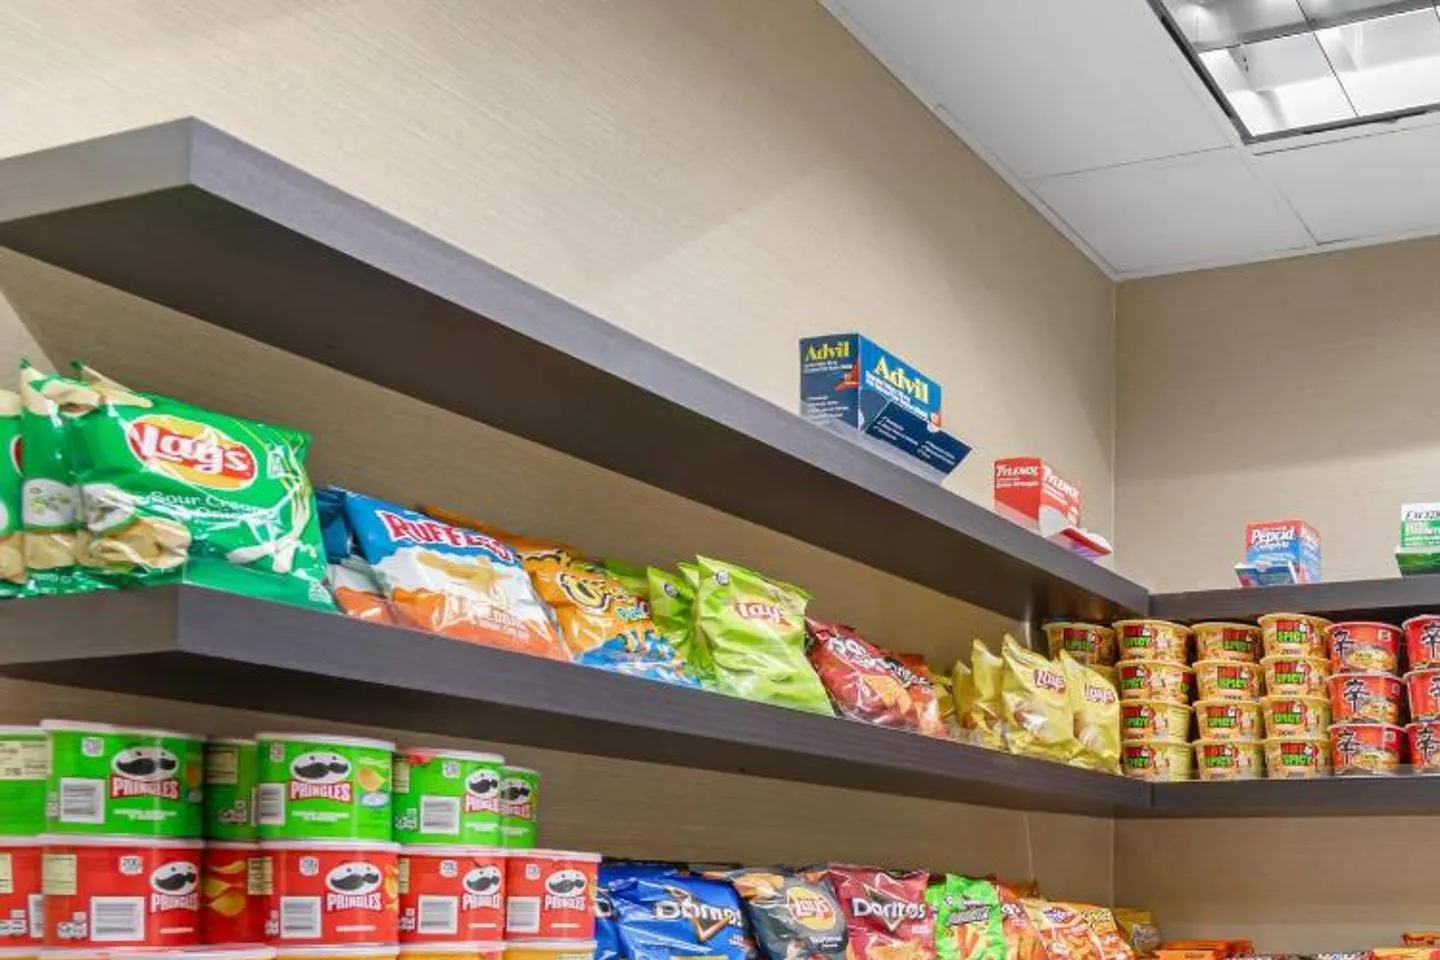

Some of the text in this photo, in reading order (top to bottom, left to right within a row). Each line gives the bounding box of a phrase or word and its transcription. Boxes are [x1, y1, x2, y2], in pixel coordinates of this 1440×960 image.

[805, 342, 850, 361] Advil
[874, 356, 929, 404] Advil
[111, 776, 179, 800] PRINGLES
[290, 781, 351, 802] PRINGLES
[326, 892, 382, 912] PRINGLES
[852, 896, 926, 920] Doritos
